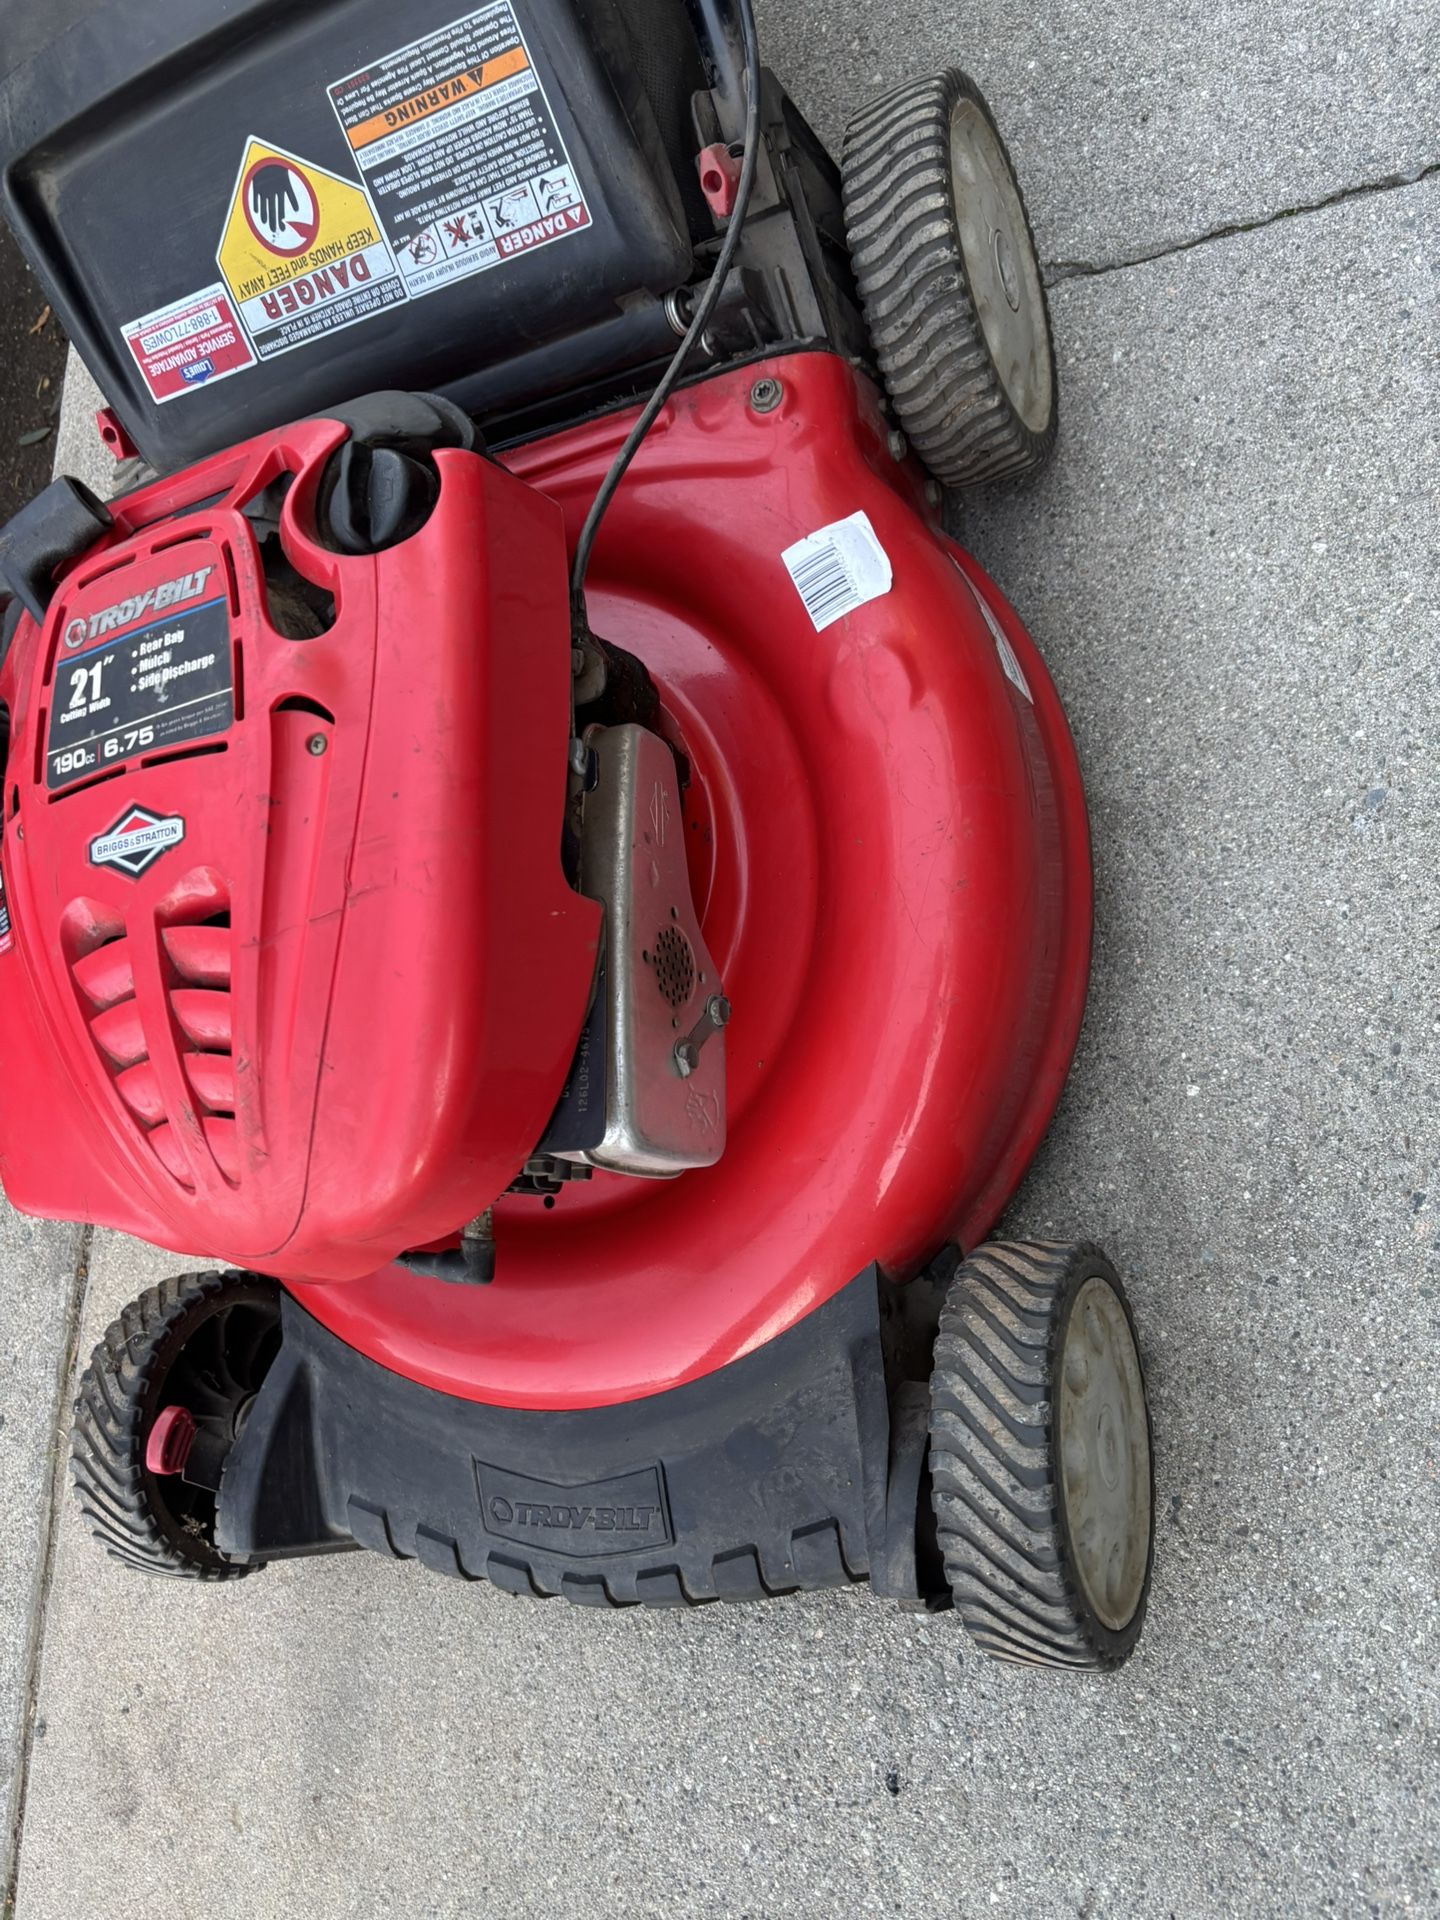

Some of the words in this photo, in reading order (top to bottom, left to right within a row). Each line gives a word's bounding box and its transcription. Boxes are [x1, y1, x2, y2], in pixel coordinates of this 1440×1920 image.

[471, 1, 508, 26] Regulations
[498, 13, 512, 25] The
[450, 24, 464, 37] Fire
[462, 20, 472, 30] To
[471, 18, 499, 39] Operator
[499, 24, 516, 37] Fires
[419, 30, 451, 52] Prevention
[449, 33, 471, 50] Should
[464, 41, 477, 54] Dry
[476, 32, 500, 49] Around
[488, 34, 520, 55] Operation
[425, 44, 449, 62] Contact
[431, 47, 465, 70] Vegetation.
[466, 54, 480, 66] This
[480, 50, 489, 59] Of
[396, 64, 409, 76] Fire
[408, 56, 425, 70] Local
[426, 64, 433, 73] A
[434, 59, 466, 81] Equipment
[369, 69, 397, 89] Agencies
[409, 66, 427, 81] Spark
[421, 74, 435, 88] May
[359, 84, 370, 95] For
[386, 76, 410, 93] Arrestor
[402, 82, 422, 97] Create
[343, 89, 359, 102] Laws
[365, 93, 375, 103] Be
[374, 86, 387, 99] May
[381, 90, 403, 107] Sparks
[335, 97, 344, 106] Or
[369, 101, 383, 113] That
[383, 76, 466, 127] WARNING
[507, 97, 530, 114] BEHIND
[343, 114, 358, 126] Start
[357, 108, 370, 119] Can
[486, 107, 509, 124] BEFORE
[516, 107, 533, 121] THAN
[456, 122, 475, 137] WHILE
[474, 117, 487, 130] AND
[491, 118, 508, 132] MOW
[505, 121, 525, 137] EXTRA
[523, 116, 536, 128] USE
[435, 131, 458, 148] MOVING
[482, 130, 507, 147] CAUTION
[518, 132, 531, 144] NOT
[529, 128, 540, 139] DO
[444, 143, 454, 154] UP
[452, 136, 471, 150] NEVER
[474, 140, 484, 151] ON
[502, 137, 519, 151] MOW
[432, 147, 446, 160] AND
[486, 144, 504, 159] WHEN
[523, 148, 547, 165] REMOVE
[432, 158, 445, 170] NOT
[443, 154, 454, 165] DO
[459, 152, 487, 170] CHILDREN
[496, 152, 515, 167] WEAR
[500, 158, 525, 176] OBJECTS
[535, 159, 551, 173] KEEP
[383, 168, 401, 182] DOWN
[400, 161, 416, 175] LOOK
[419, 163, 434, 176] MOW
[451, 164, 461, 174] OR
[476, 160, 498, 176] SAFETY
[485, 169, 501, 182] THAT
[516, 165, 537, 181] HANDS
[372, 175, 385, 187] AND
[399, 169, 420, 185] SLOPES
[419, 177, 431, 189] ARE
[430, 168, 452, 184] OTHERS
[474, 175, 487, 187] CAN
[504, 174, 518, 186] AND
[376, 178, 401, 196] GREATER
[395, 182, 421, 199] AROUND.
[444, 184, 468, 201] THROWN
[467, 180, 476, 190] BE
[475, 185, 493, 199] AWAY
[491, 179, 506, 192] FEET
[426, 197, 438, 209] THE
[436, 194, 445, 204] BY
[459, 192, 477, 206] FROM
[403, 209, 411, 219] IN
[409, 202, 427, 216] BLADE
[434, 199, 461, 217] ROTATING
[392, 212, 405, 224] ANY
[415, 210, 435, 226] PARTS.
[343, 226, 374, 251] KEEP
[499, 213, 567, 253] DANGER
[307, 239, 345, 266] HANDS
[478, 245, 497, 258] AVOID
[289, 255, 310, 274] and
[454, 252, 479, 269] SERIOUS
[264, 263, 291, 285] FEET
[424, 270, 435, 281] OR
[434, 262, 455, 277] INJURY
[236, 274, 267, 298] AWAY
[259, 252, 372, 322] DANGER
[379, 278, 400, 293] COVER
[408, 274, 425, 288] DEATH
[351, 290, 371, 305] ENTIRE
[369, 286, 381, 297] OR
[380, 291, 394, 304] NOT
[392, 287, 404, 298] DO
[333, 297, 353, 313] GRASS
[354, 296, 381, 314] OPERATE
[302, 315, 311, 326] IS
[309, 305, 335, 323] CATCHER
[331, 307, 355, 324] UNLESS
[277, 321, 297, 337] PLACE.
[295, 318, 304, 329] IN
[322, 317, 332, 328] AN
[287, 320, 323, 342] UNDAMAGED
[196, 330, 236, 356] SERVICE
[258, 335, 289, 354] DISCHARGE
[147, 346, 198, 376] ADVANTAGE
[181, 359, 211, 379] LOWE'S
[88, 566, 211, 639] TROY-BILT
[139, 640, 163, 656] Rear
[164, 630, 185, 646] Bag
[139, 650, 171, 673] Mulch
[139, 671, 161, 691] Side
[162, 654, 215, 684] Discharge
[60, 707, 87, 724] Cutting
[89, 697, 112, 714] Width
[104, 725, 154, 758] 6.75
[53, 748, 96, 775] 190cc
[514, 1501, 655, 1531] TROY-BILT
